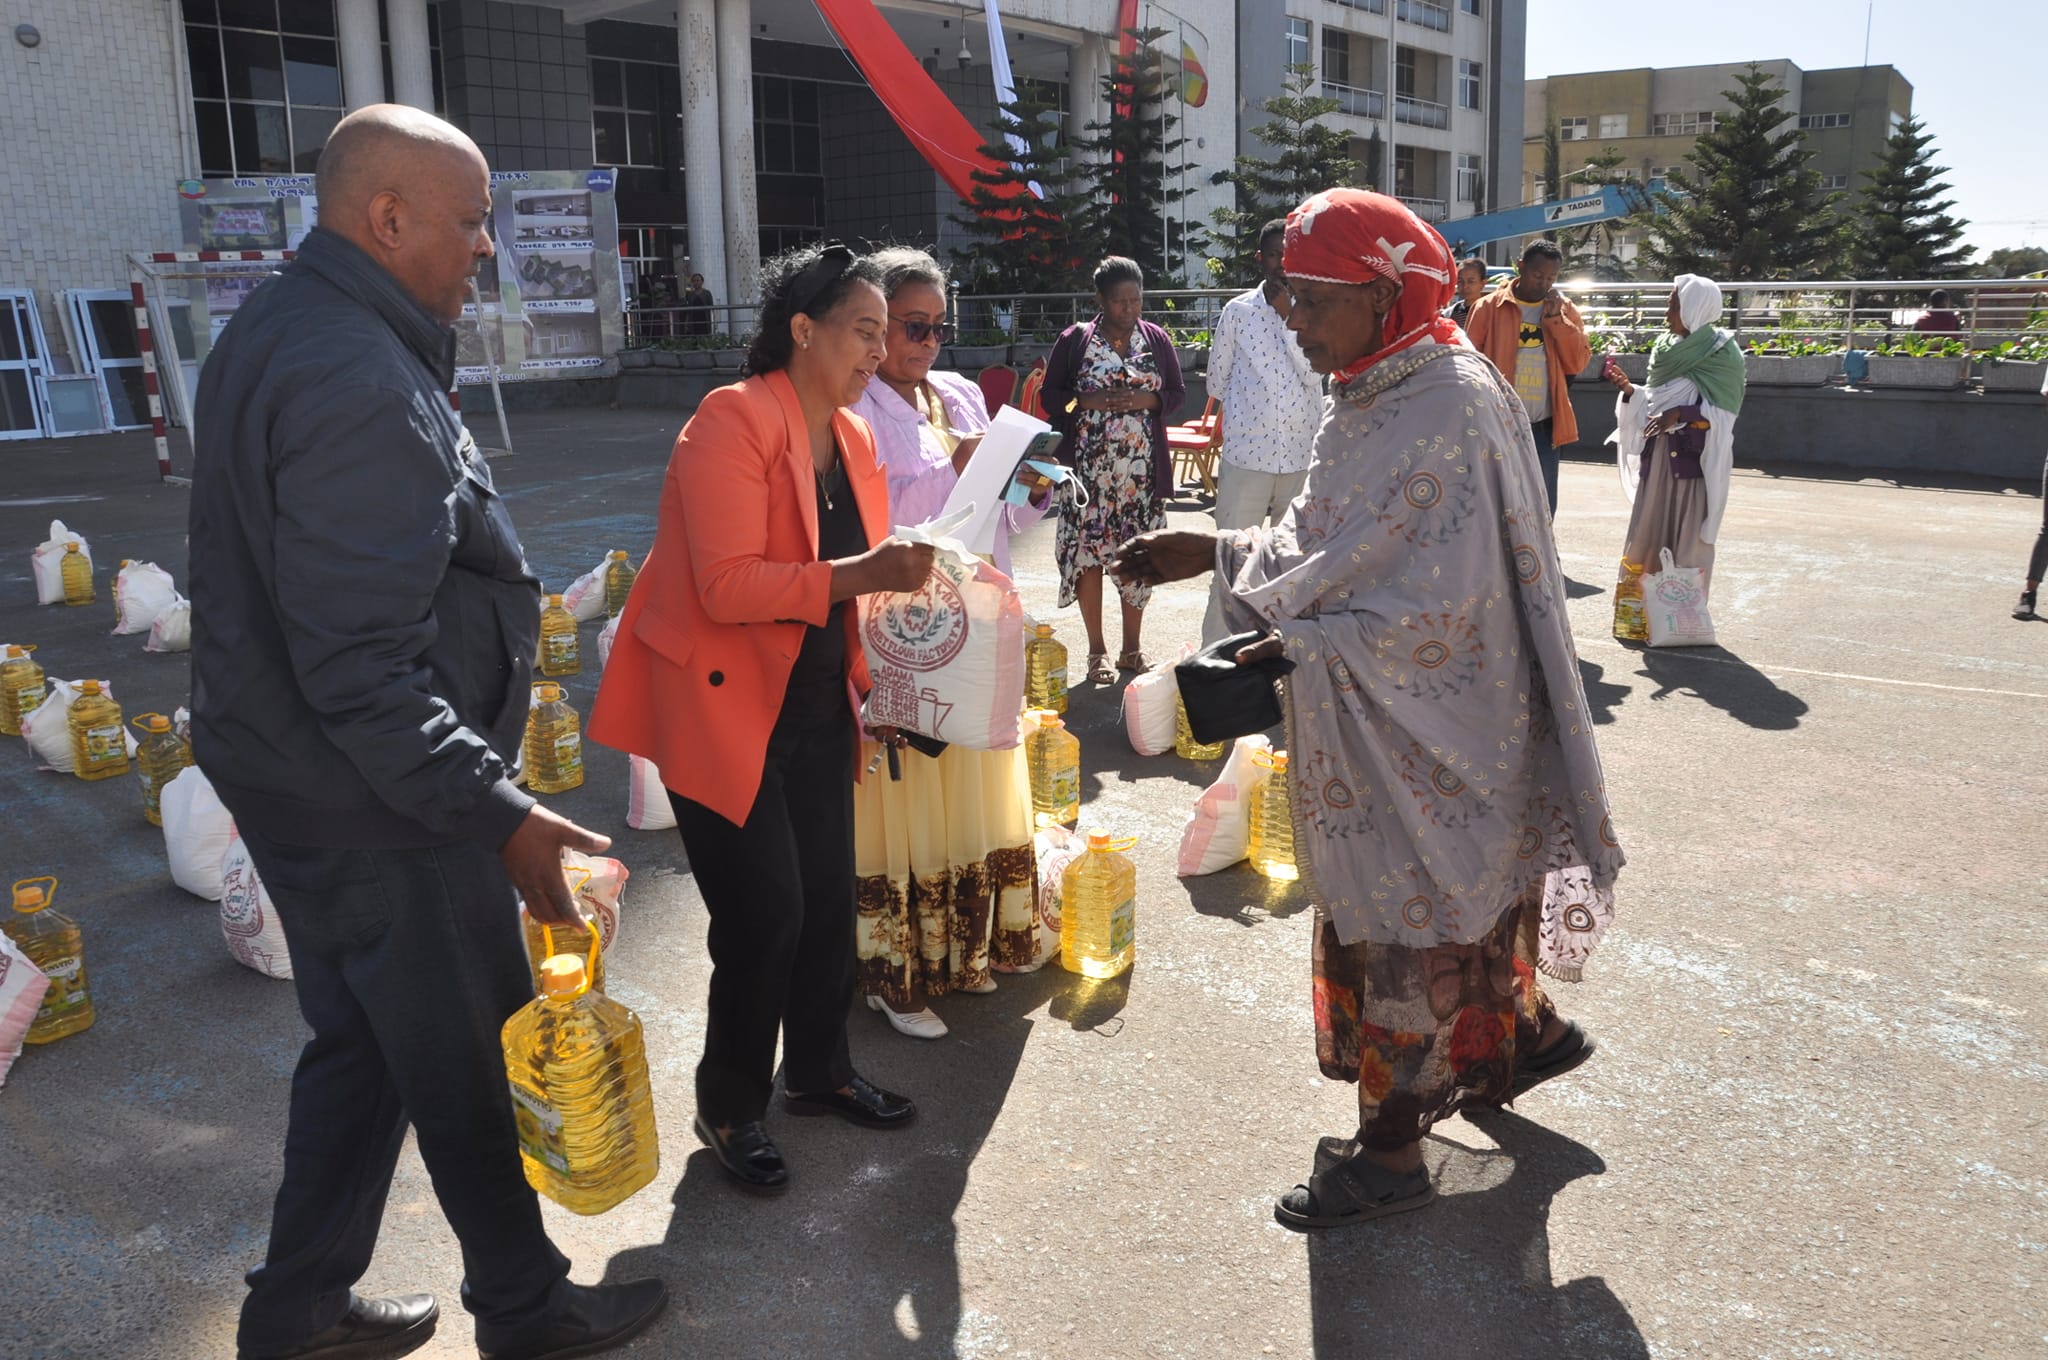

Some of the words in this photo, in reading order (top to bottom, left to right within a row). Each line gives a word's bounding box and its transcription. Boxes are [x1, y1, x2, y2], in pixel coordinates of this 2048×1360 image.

[490, 172, 528, 181] ጀክቶችና
[1567, 199, 1602, 211] TADANO
[887, 641, 917, 660] FLOUR
[917, 631, 958, 661] FACTORY
[881, 664, 914, 682] ADAMA
